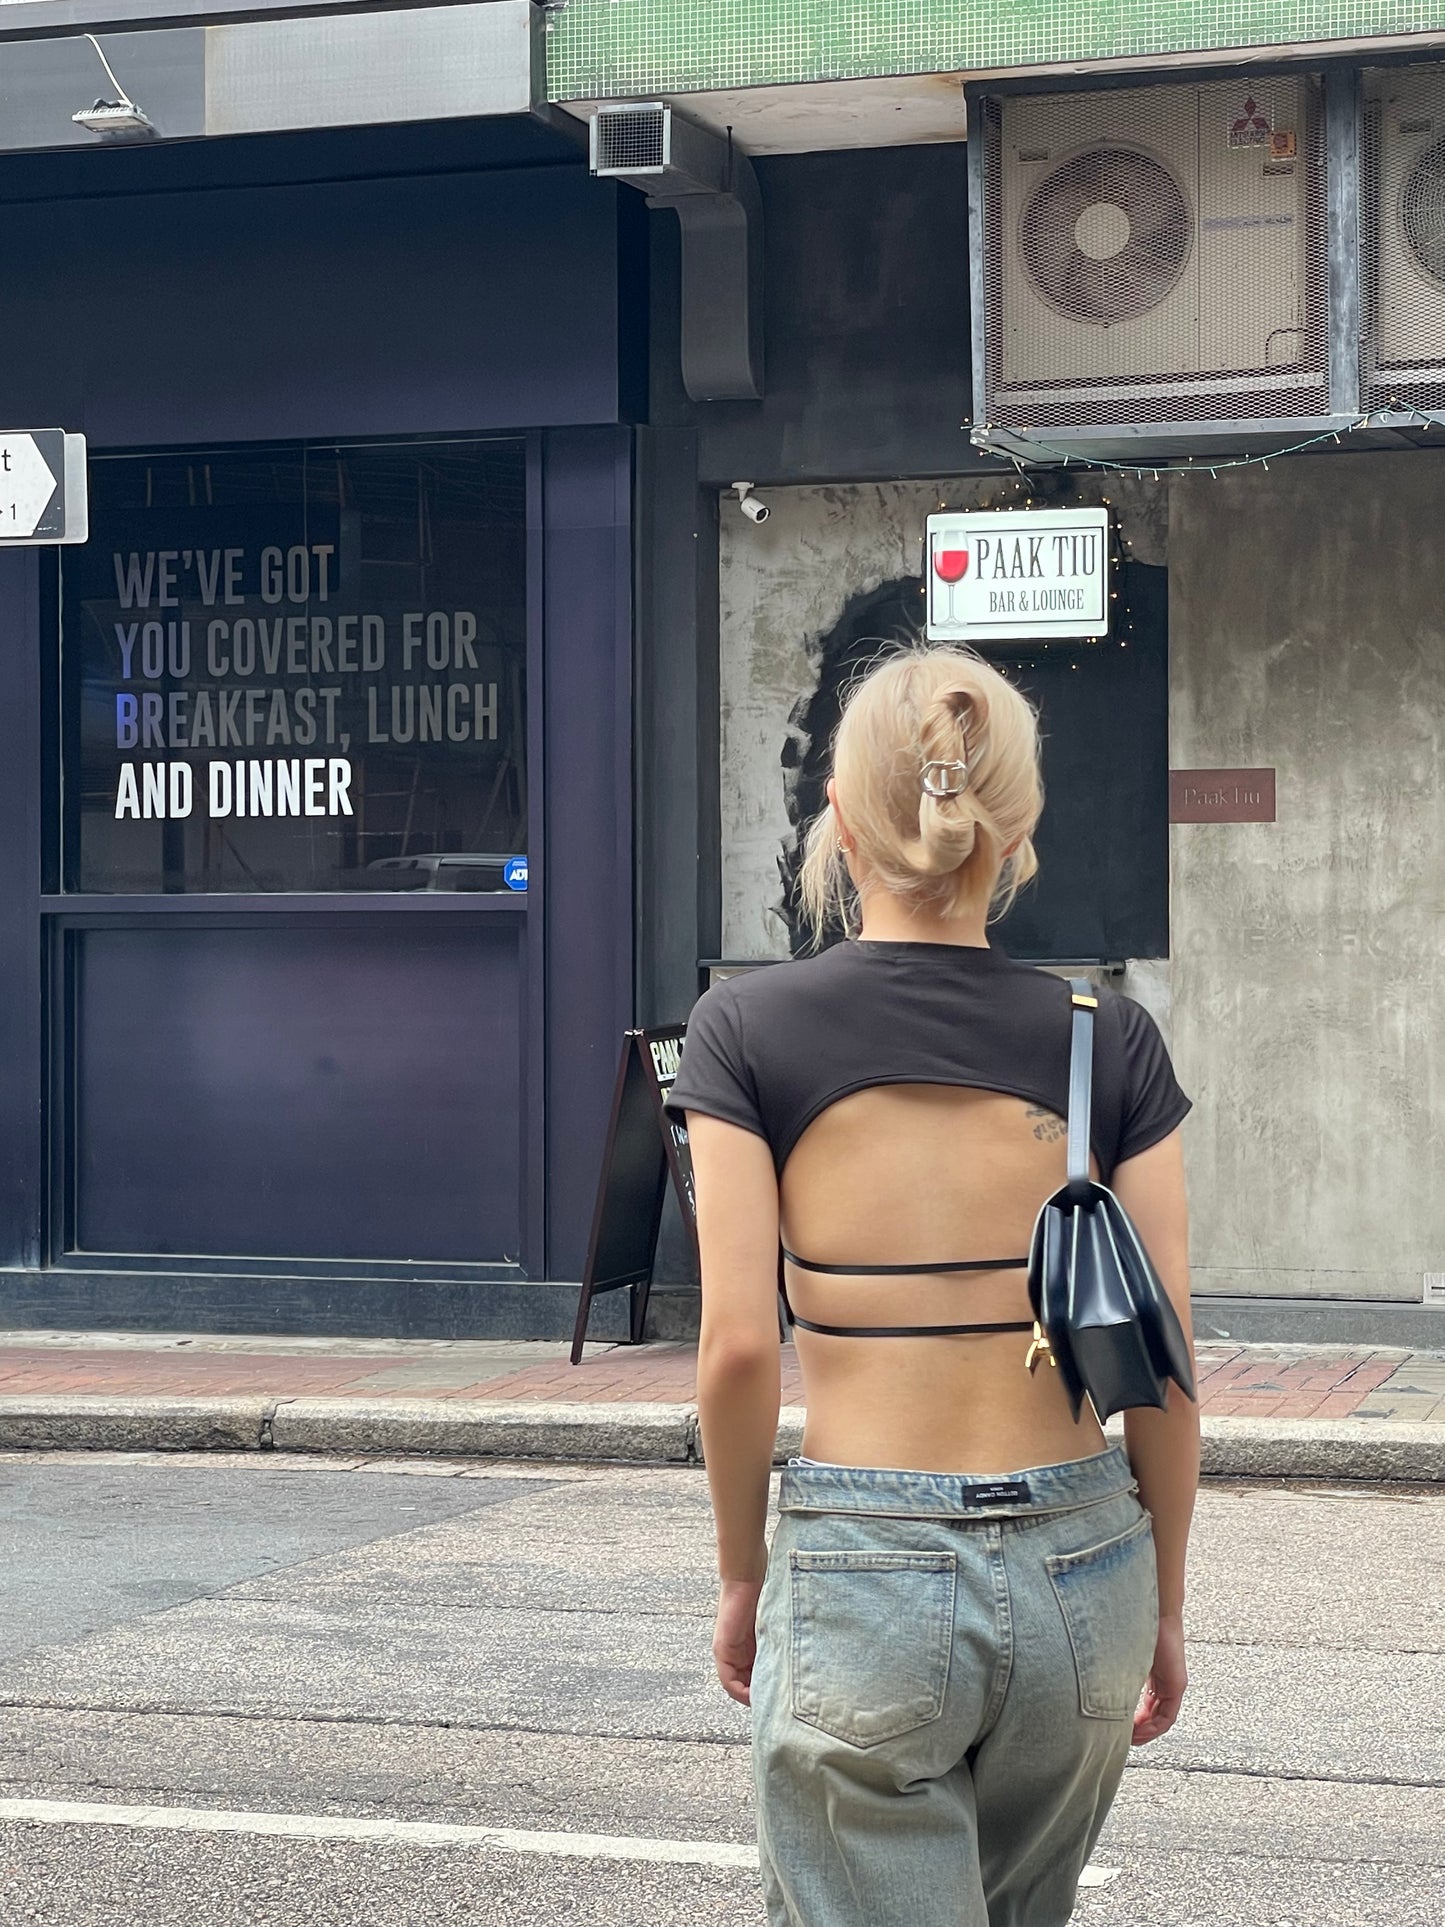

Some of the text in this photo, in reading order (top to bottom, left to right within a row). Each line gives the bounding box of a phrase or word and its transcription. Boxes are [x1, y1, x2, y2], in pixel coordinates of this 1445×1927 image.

[10, 503, 16, 520] 1
[113, 544, 335, 609] WE'VE GOT
[975, 534, 1097, 580] PAAK TIU
[989, 588, 1084, 613] BAR & LOUNGE
[114, 611, 479, 680] YOU COVERED FOR
[116, 682, 498, 753] BREAKFAST, LUNCH
[114, 758, 354, 819] AND DINNER
[1184, 786, 1228, 806] Paak
